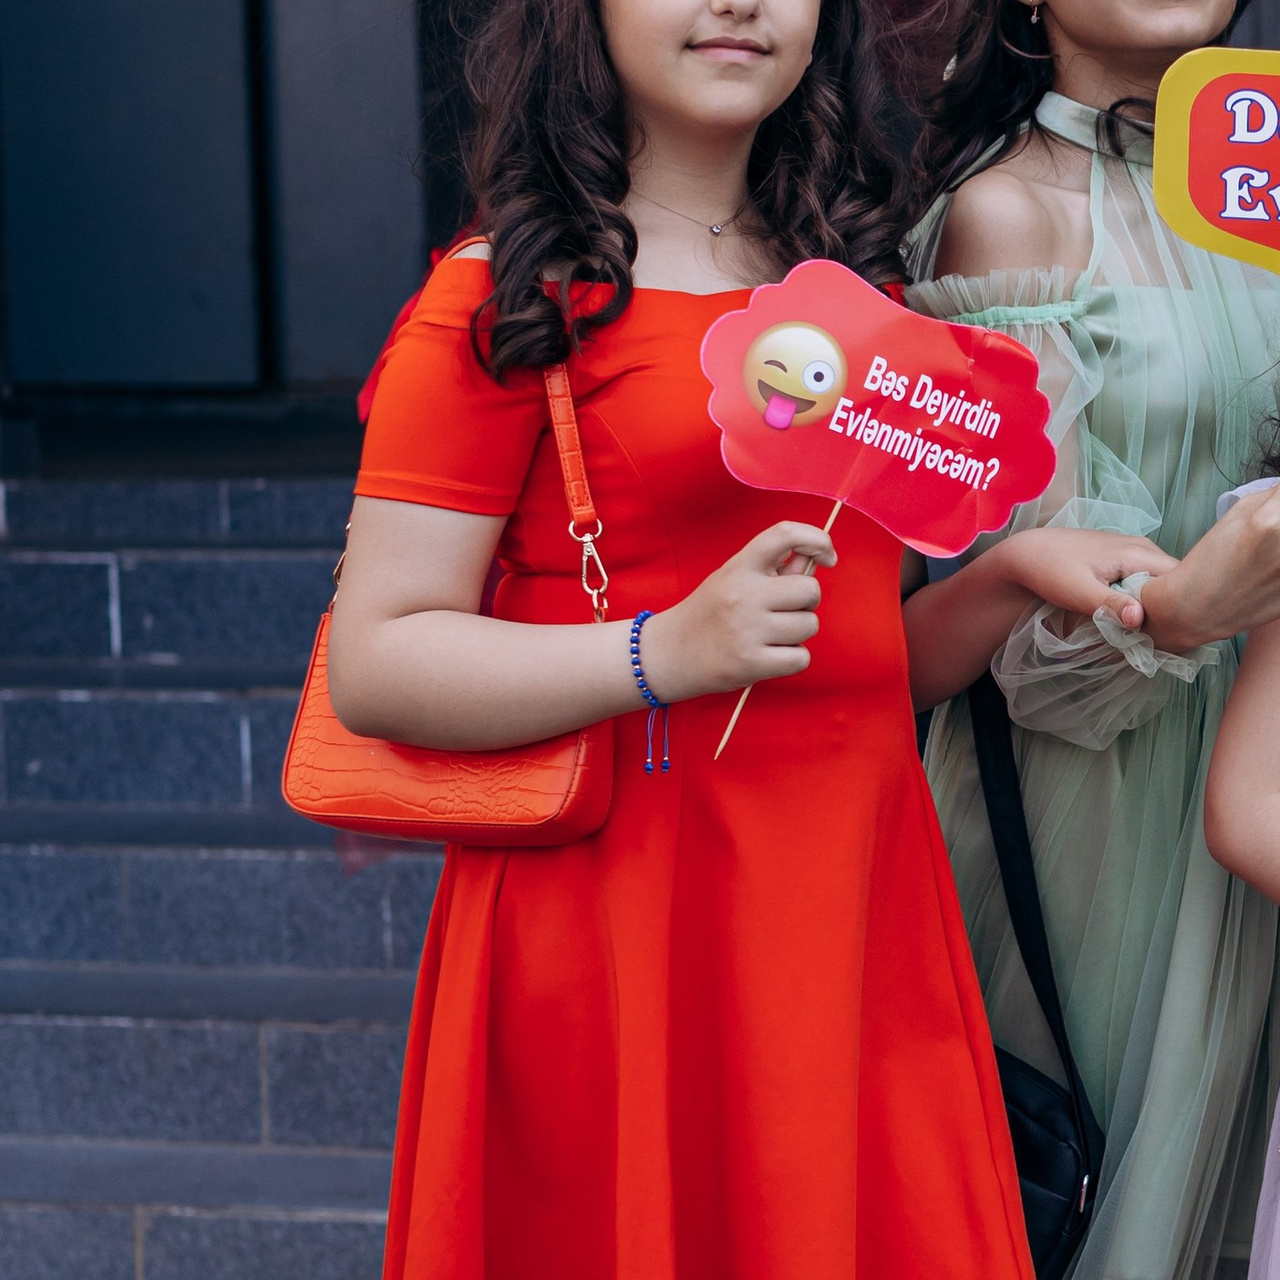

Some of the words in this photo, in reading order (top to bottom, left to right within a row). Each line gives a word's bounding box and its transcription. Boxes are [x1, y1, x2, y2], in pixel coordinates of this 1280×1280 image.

[863, 356, 909, 402] Bəs
[909, 374, 1001, 439] Deyirdin
[828, 396, 1000, 491] Evlənmiyəcəm?
